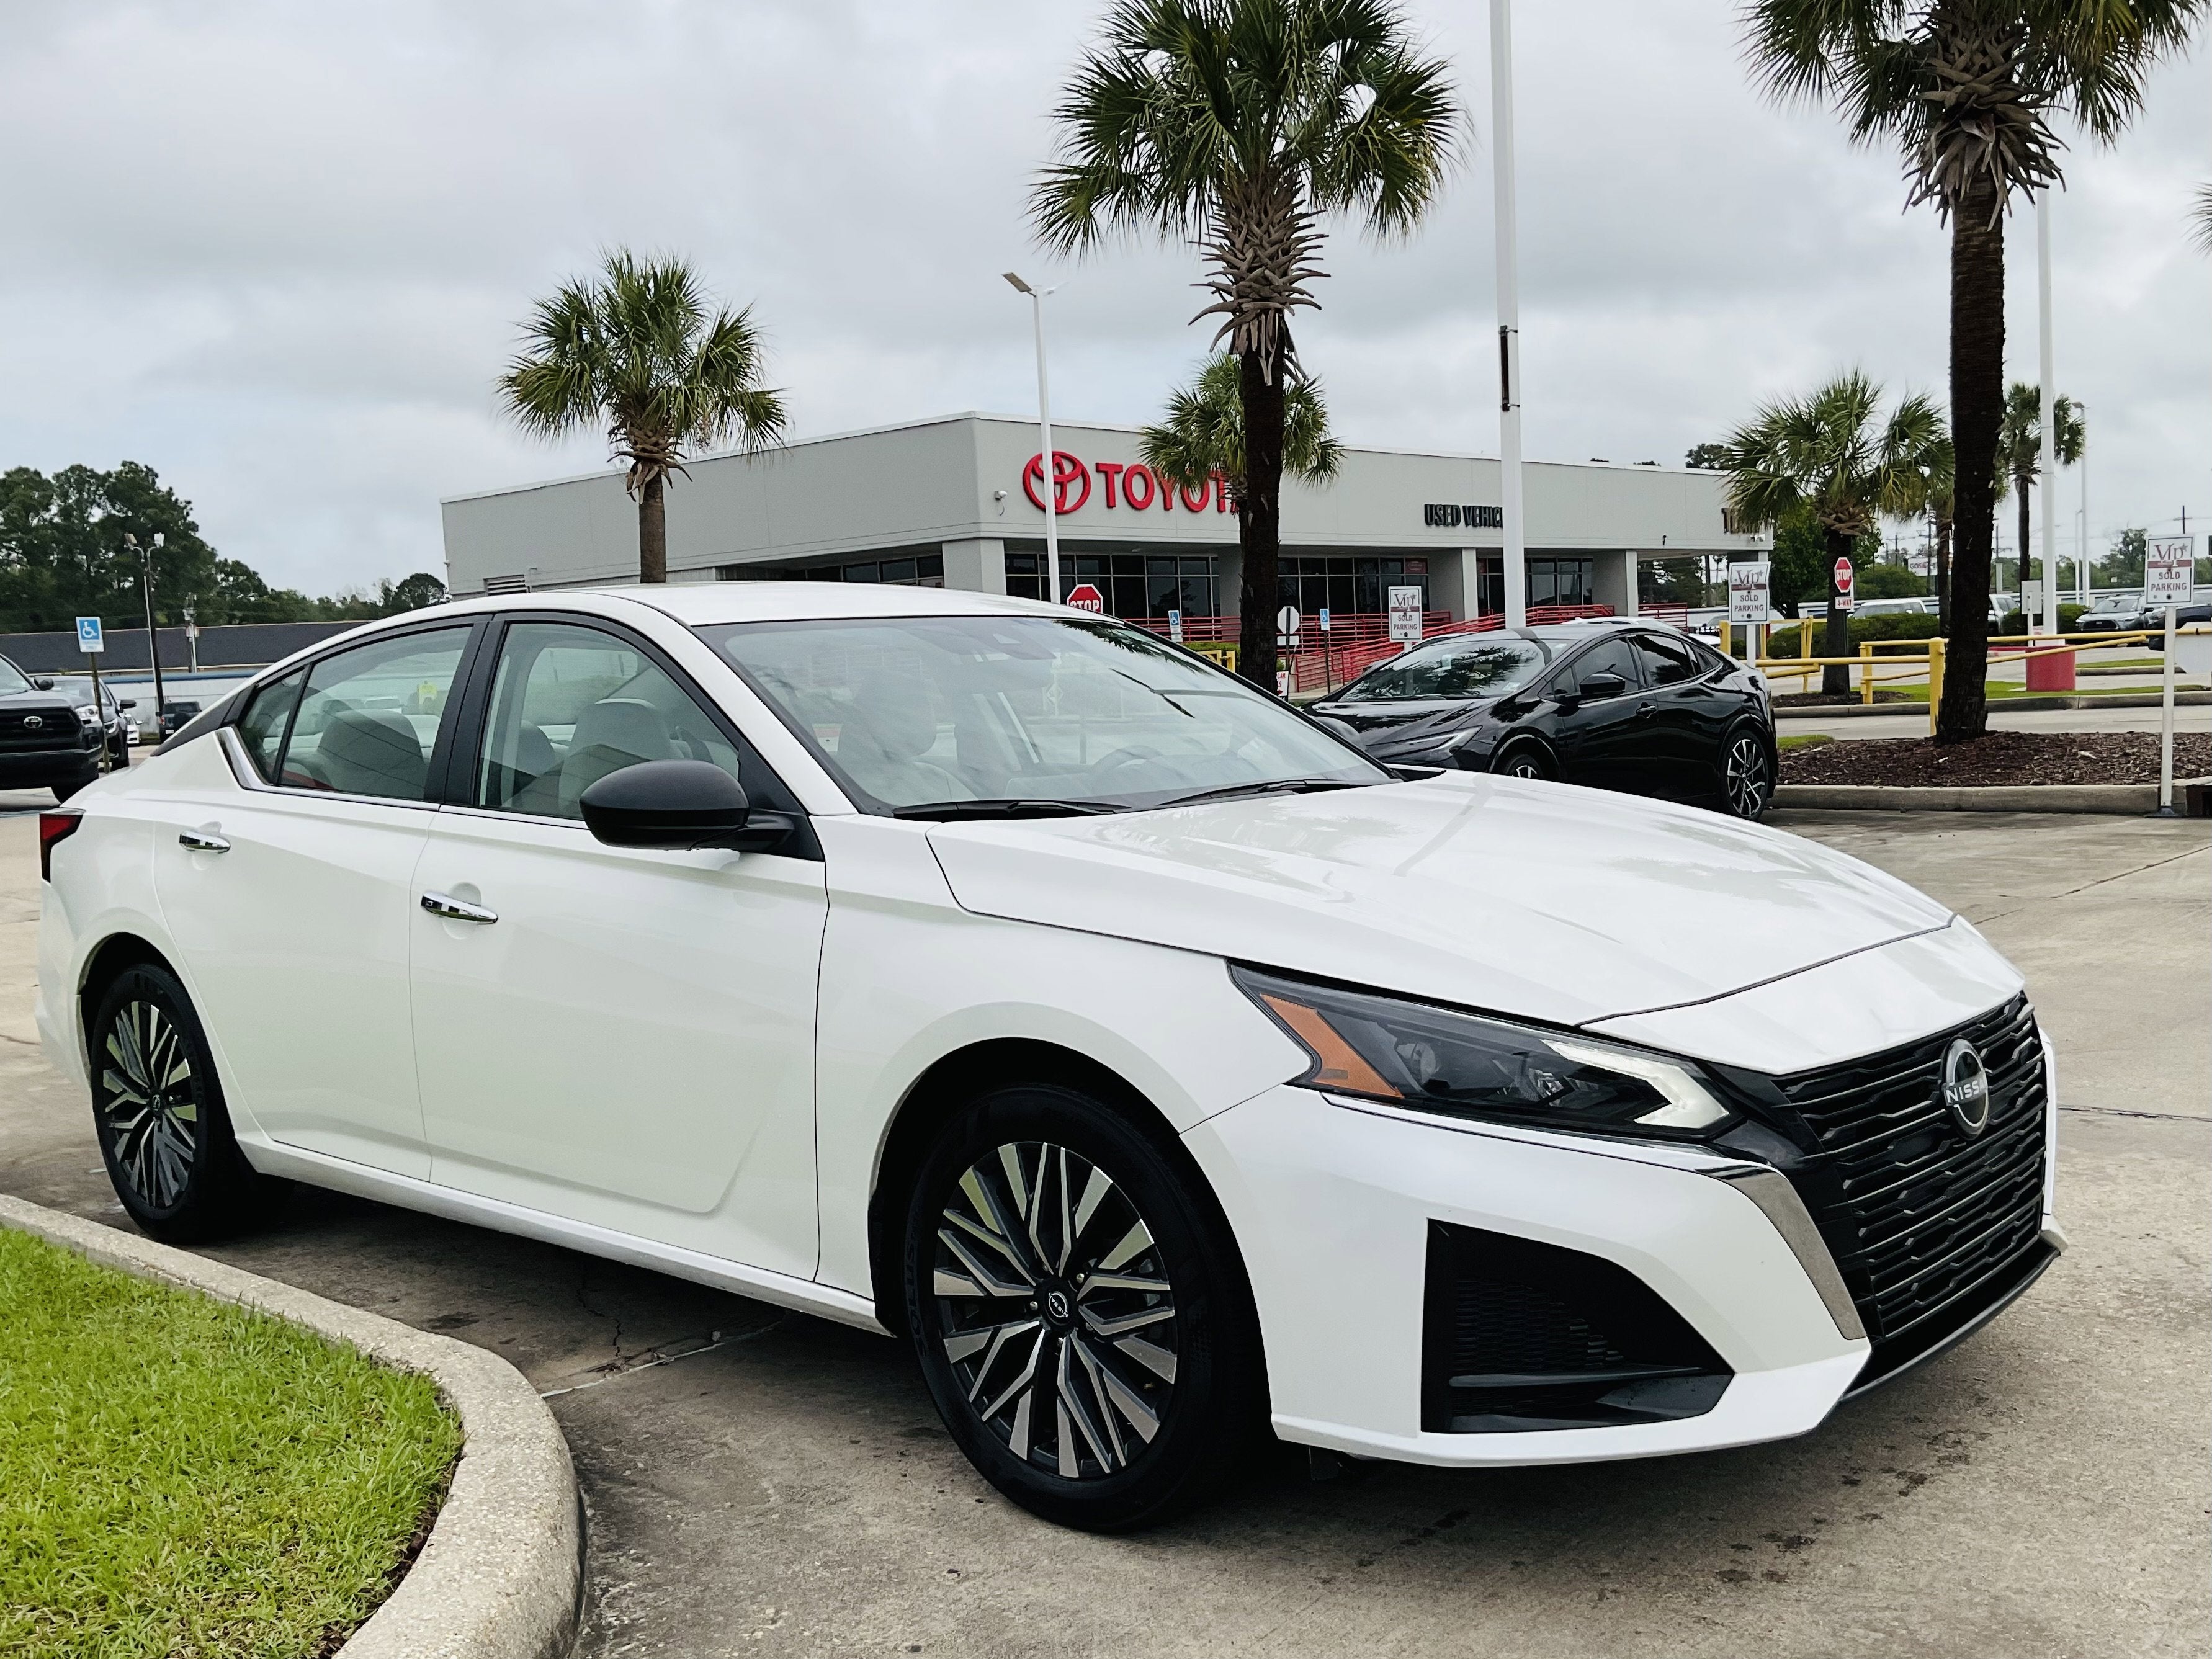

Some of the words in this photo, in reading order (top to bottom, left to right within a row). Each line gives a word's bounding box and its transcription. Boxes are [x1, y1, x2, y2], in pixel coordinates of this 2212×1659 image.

[1096, 463, 1240, 514] TOYOT
[1425, 504, 1461, 526] USED
[1462, 505, 1503, 527] VEHIC
[1837, 569, 1851, 581] STOP
[2159, 571, 2180, 579] SOLD
[2151, 583, 2187, 591] PARKING
[1946, 1078, 1987, 1104] NISSA
